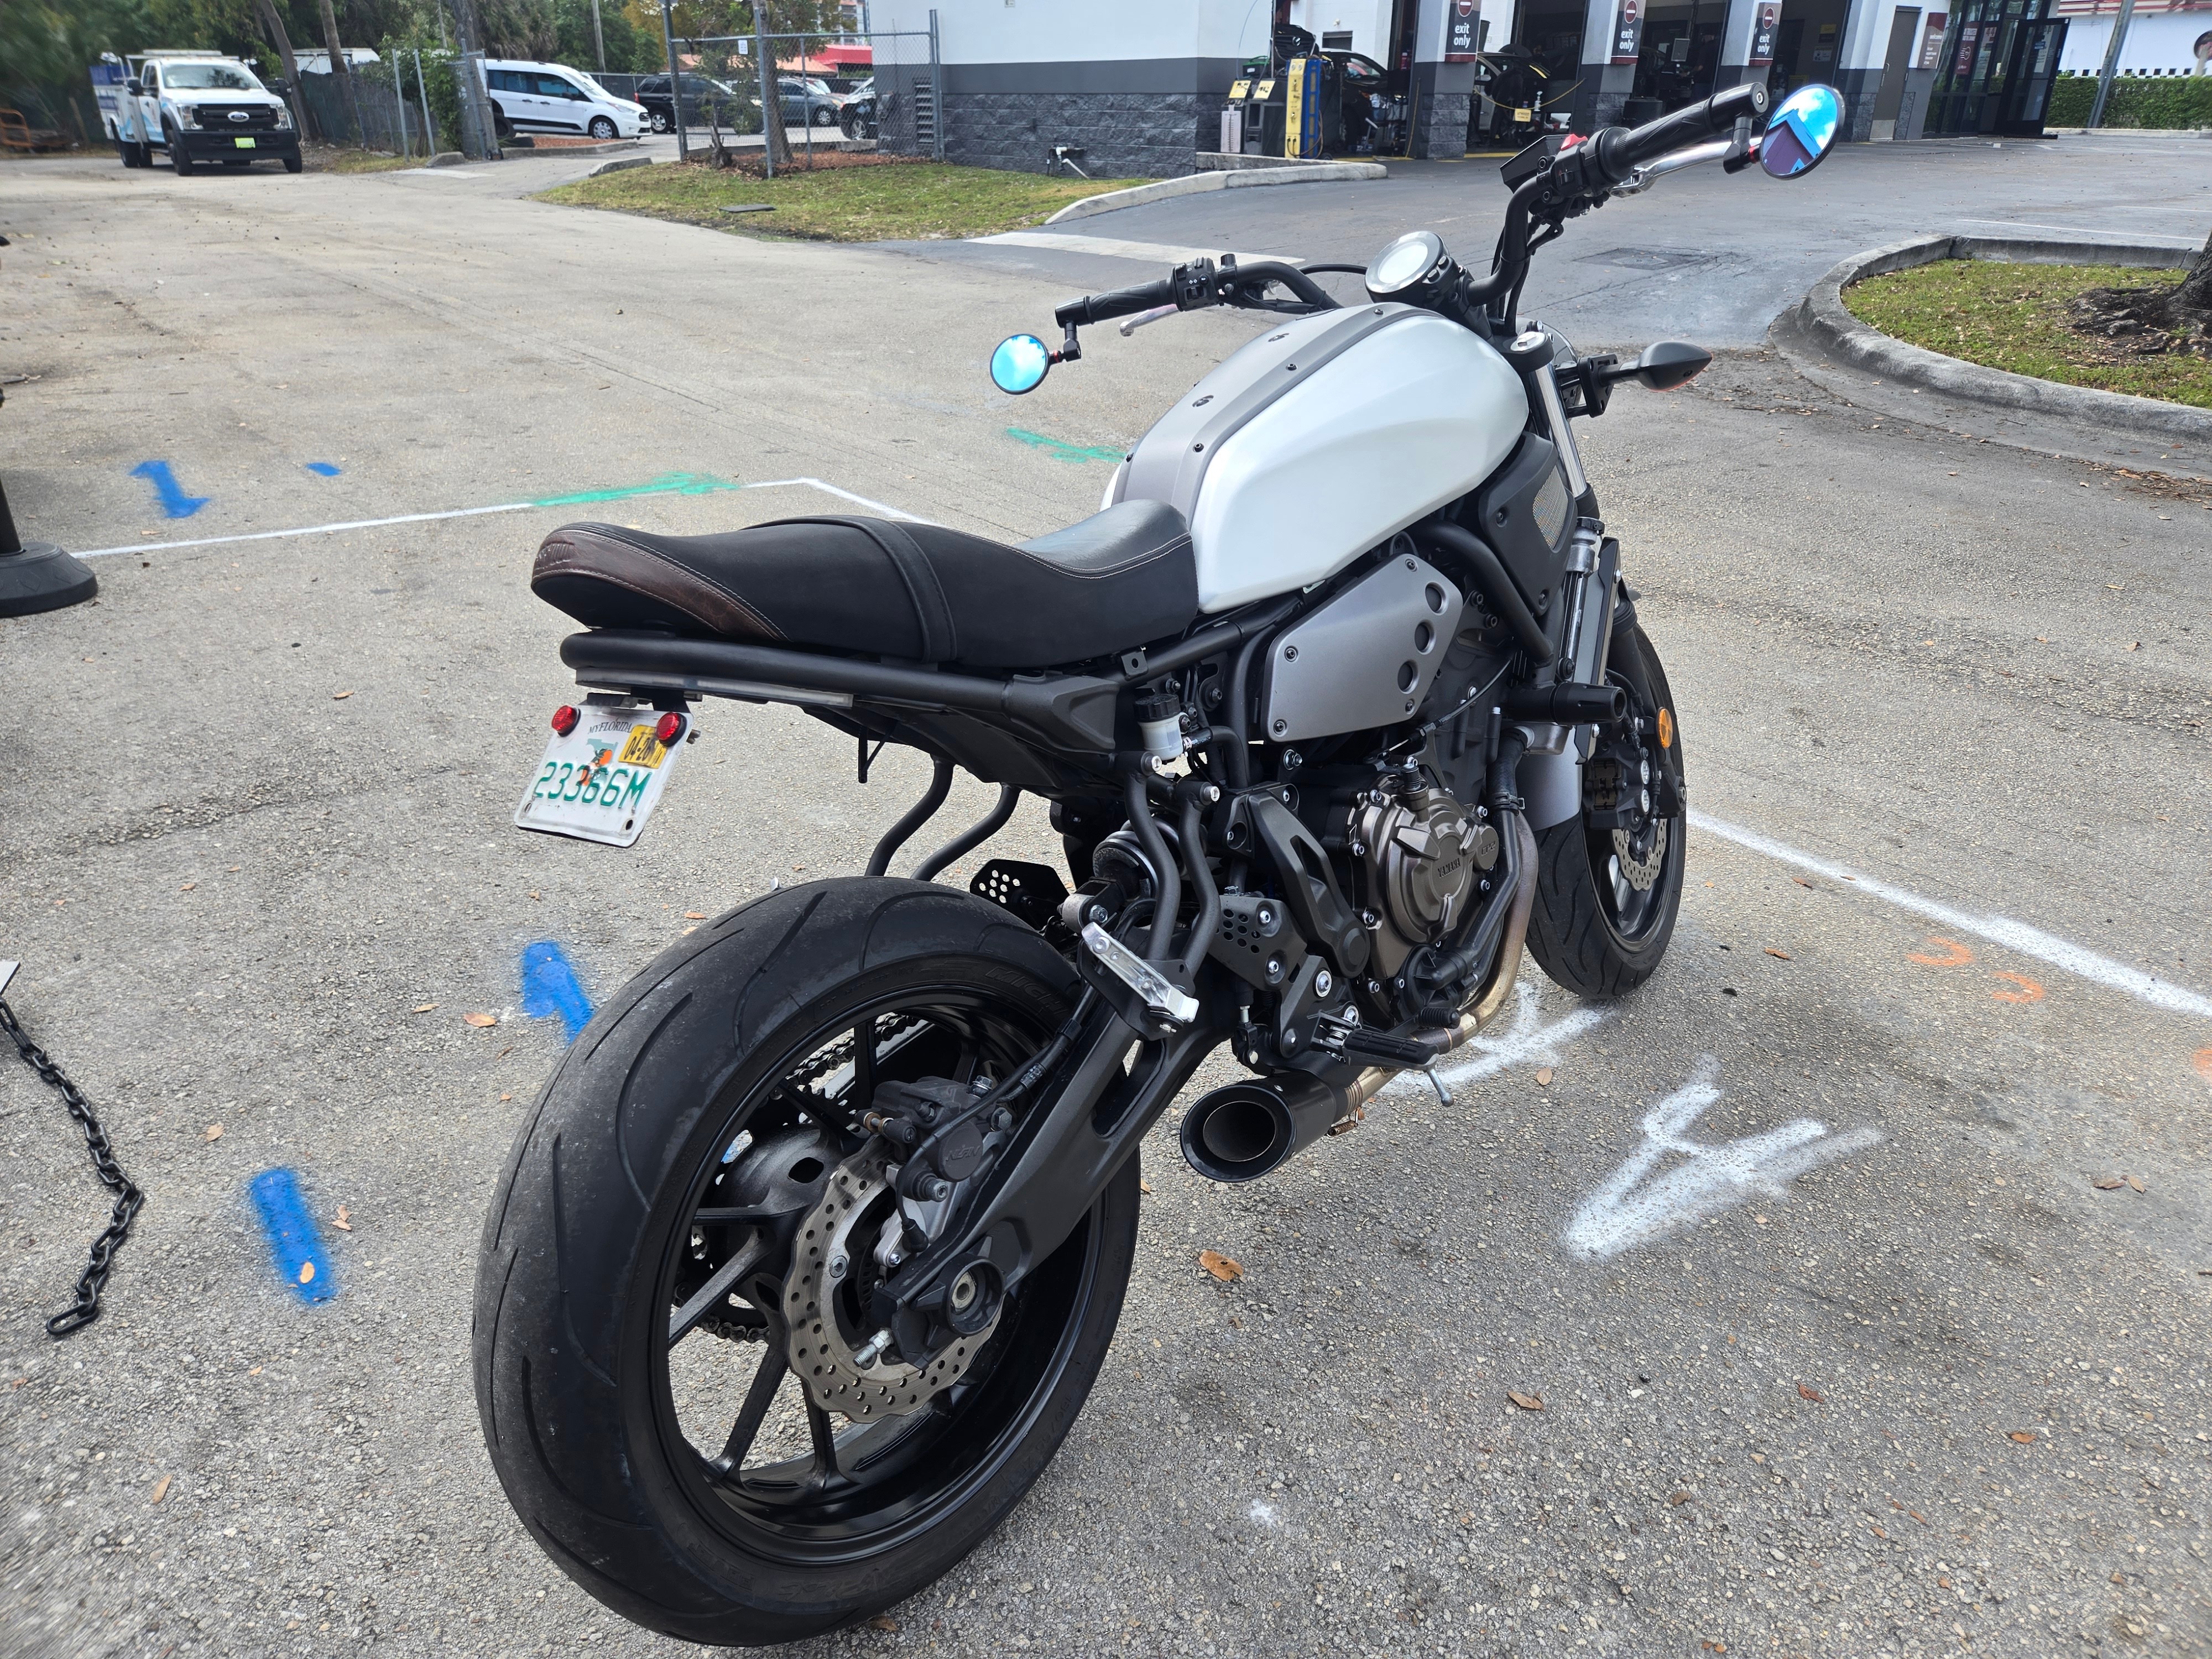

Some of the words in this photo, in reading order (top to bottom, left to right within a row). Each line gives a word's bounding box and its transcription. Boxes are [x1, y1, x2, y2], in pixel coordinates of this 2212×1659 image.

[1454, 22, 1470, 34] exit
[1621, 28, 1634, 39] exit
[1453, 34, 1471, 49] only
[1759, 33, 1770, 43] exit
[1619, 39, 1634, 52] only
[1757, 43, 1770, 55] only
[534, 761, 653, 808] 23366M
[1438, 857, 1461, 878] YAMAHA
